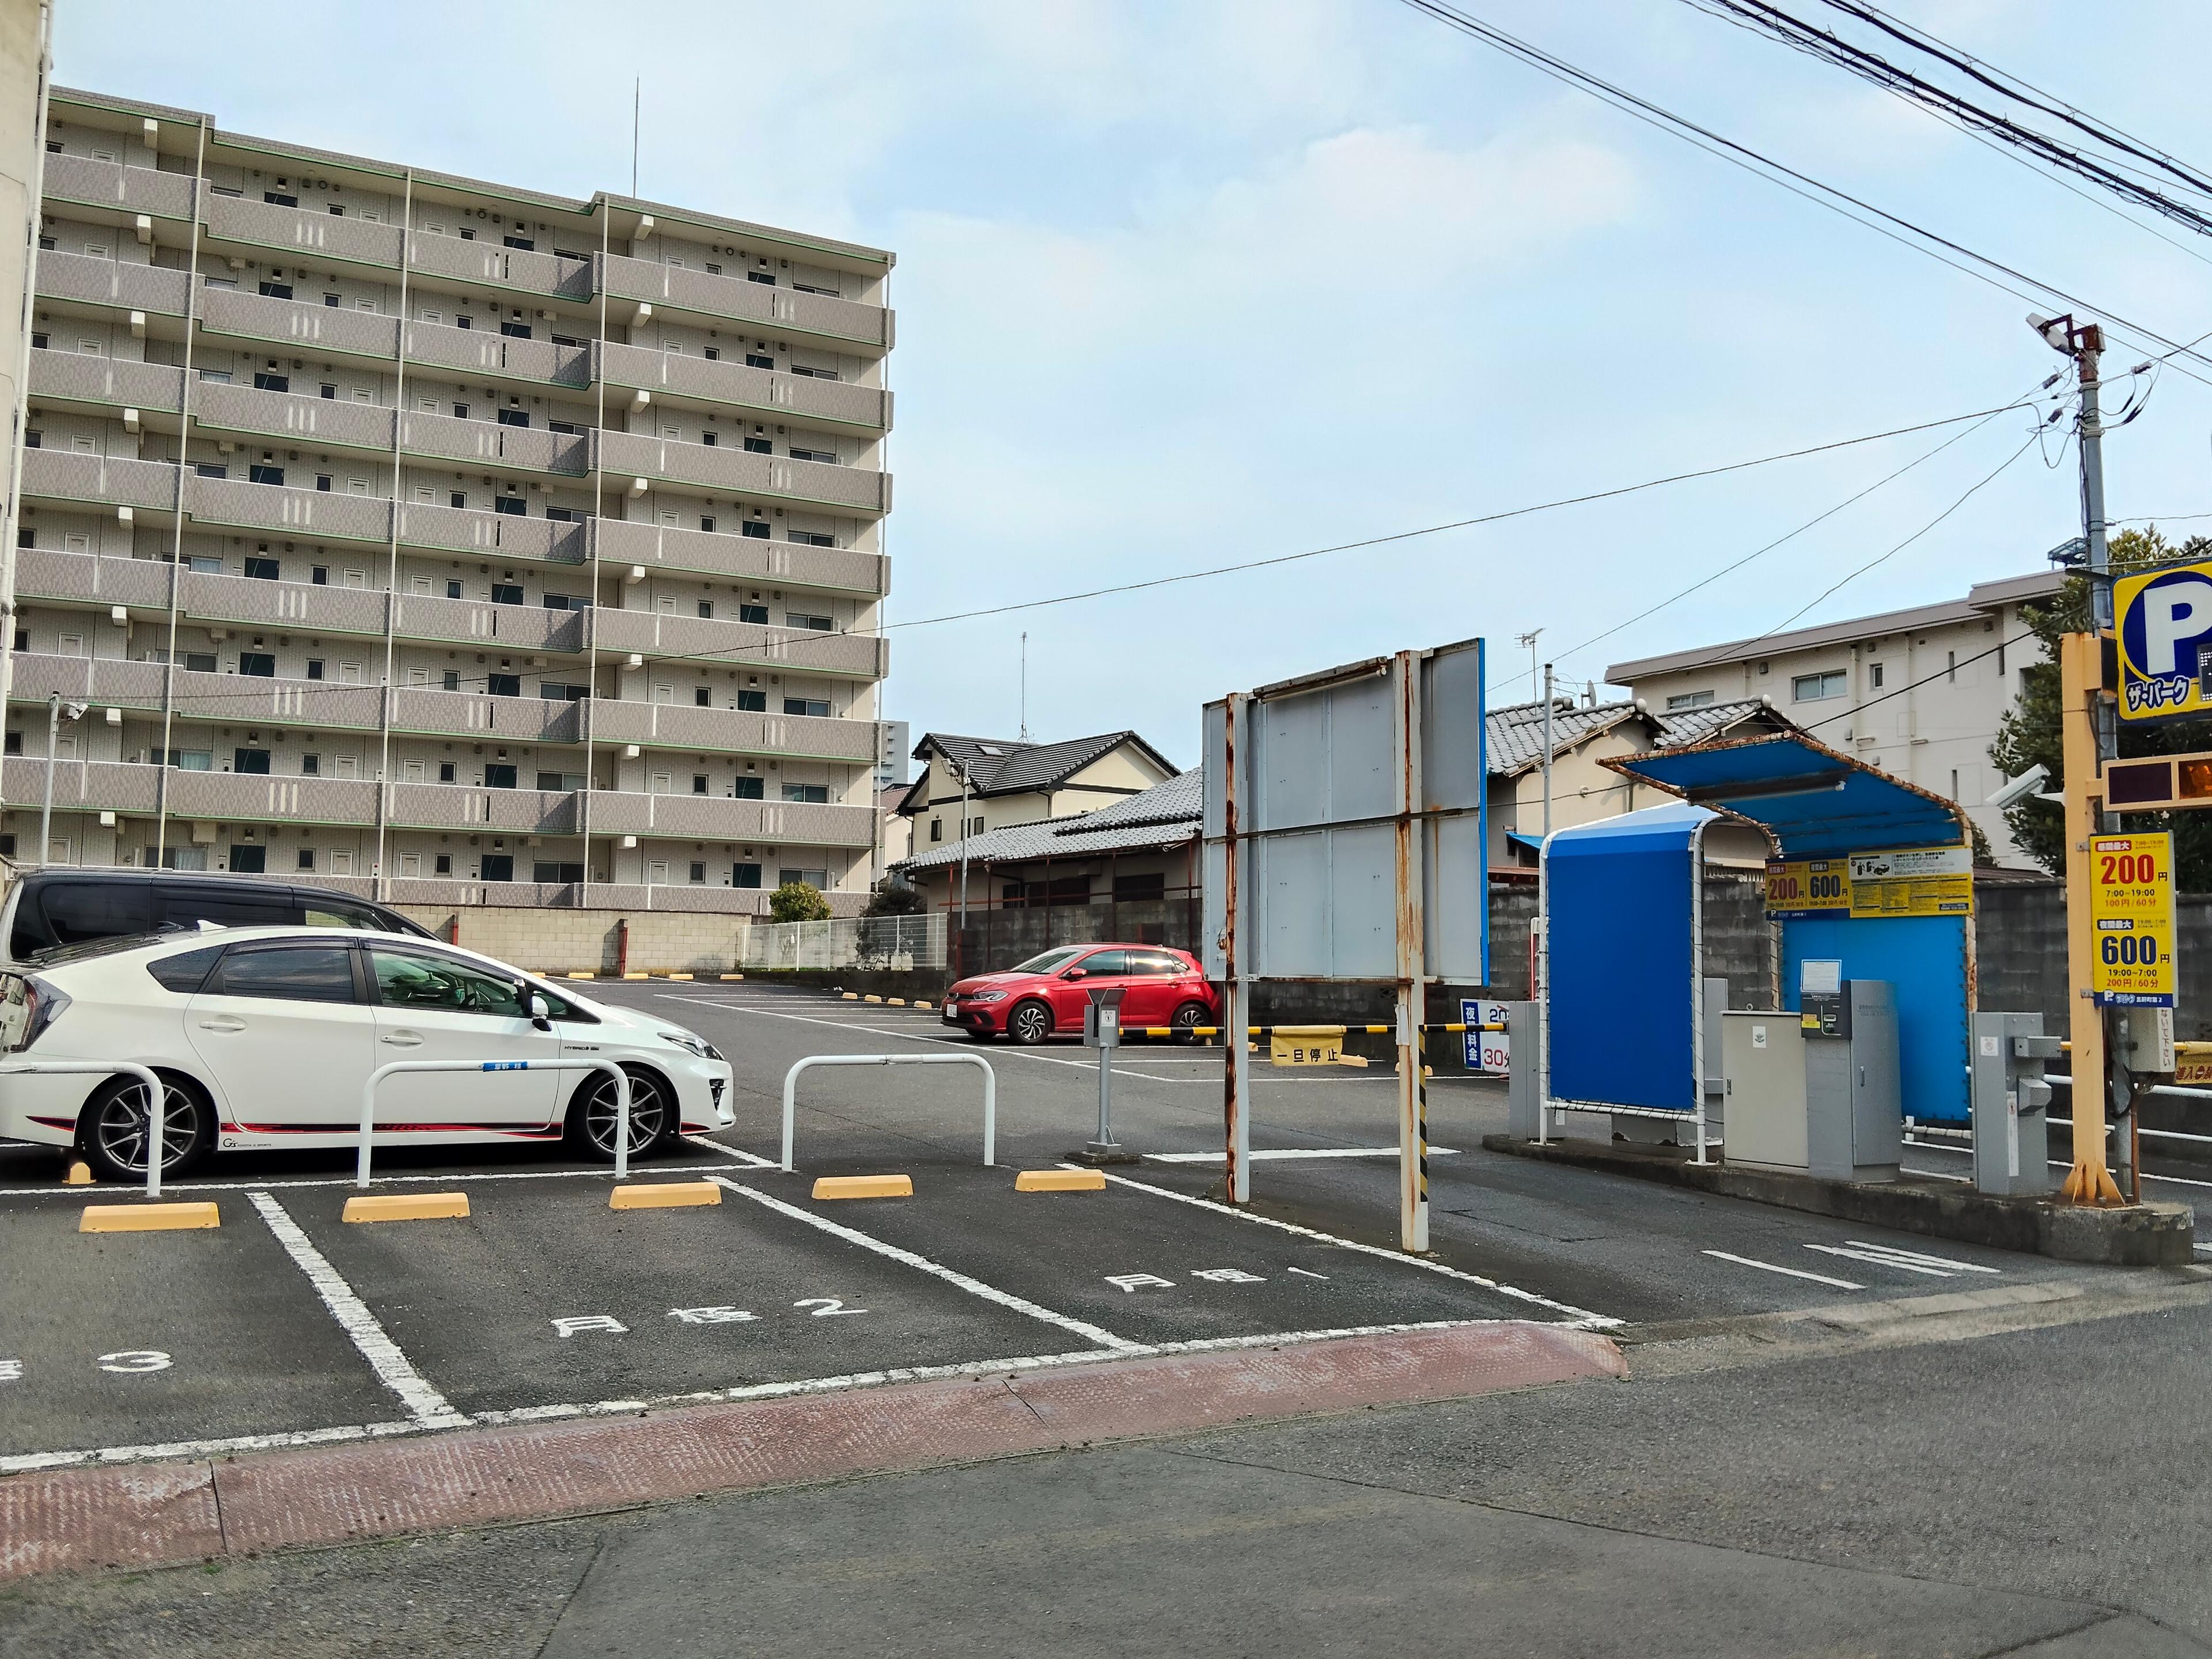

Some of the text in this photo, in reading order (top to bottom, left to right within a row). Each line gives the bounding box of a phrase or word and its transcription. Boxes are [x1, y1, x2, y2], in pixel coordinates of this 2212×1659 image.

[2144, 581, 2212, 675] P
[2127, 676, 2190, 712] ザ・パーク
[2100, 854, 2168, 885] 200円
[1768, 877, 1804, 900] 200円
[1810, 875, 1847, 899] 600円
[2101, 935, 2170, 965] 600円
[1277, 1048, 1339, 1063] 一旦停止
